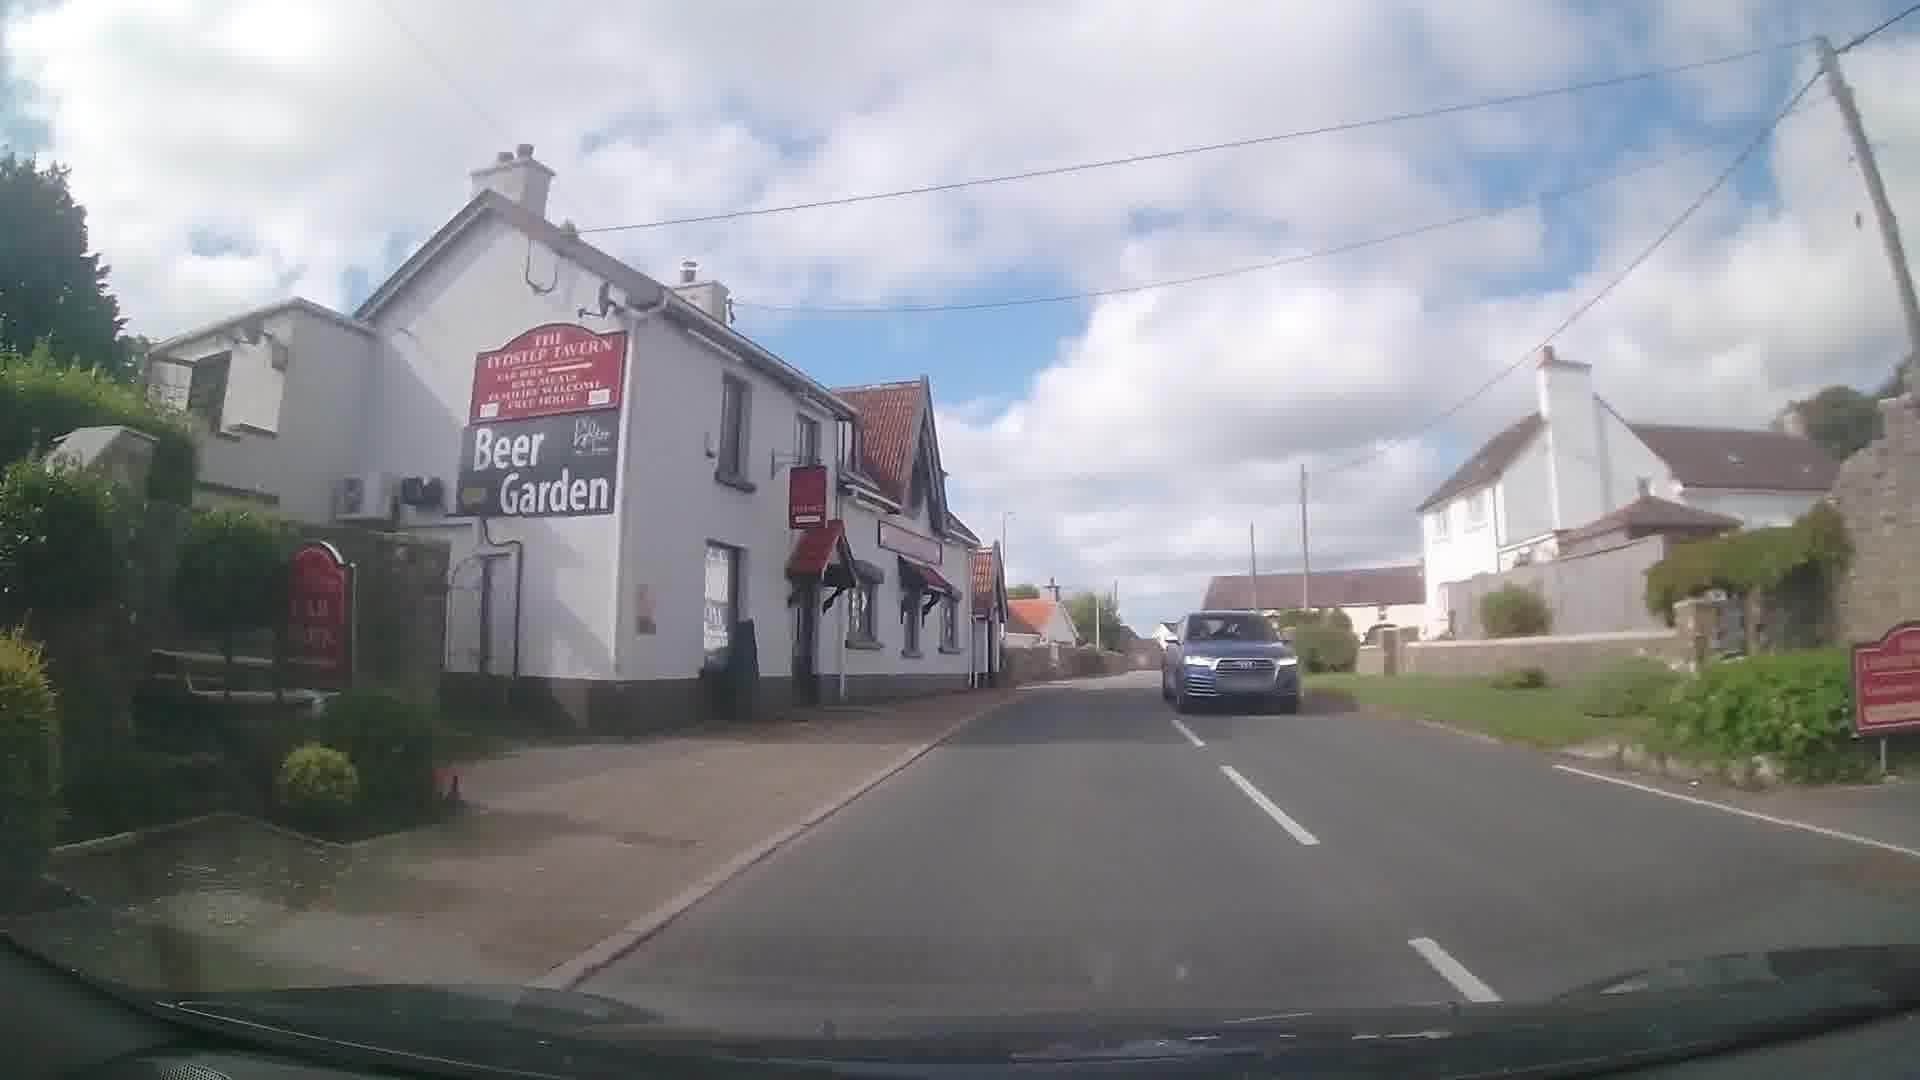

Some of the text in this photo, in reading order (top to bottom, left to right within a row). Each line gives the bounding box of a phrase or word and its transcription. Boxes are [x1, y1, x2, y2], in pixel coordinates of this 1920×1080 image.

[554, 339, 613, 358] TAVERN
[541, 379, 601, 397] WELCOME
[473, 428, 545, 471] Beer
[501, 468, 608, 514] Garden
